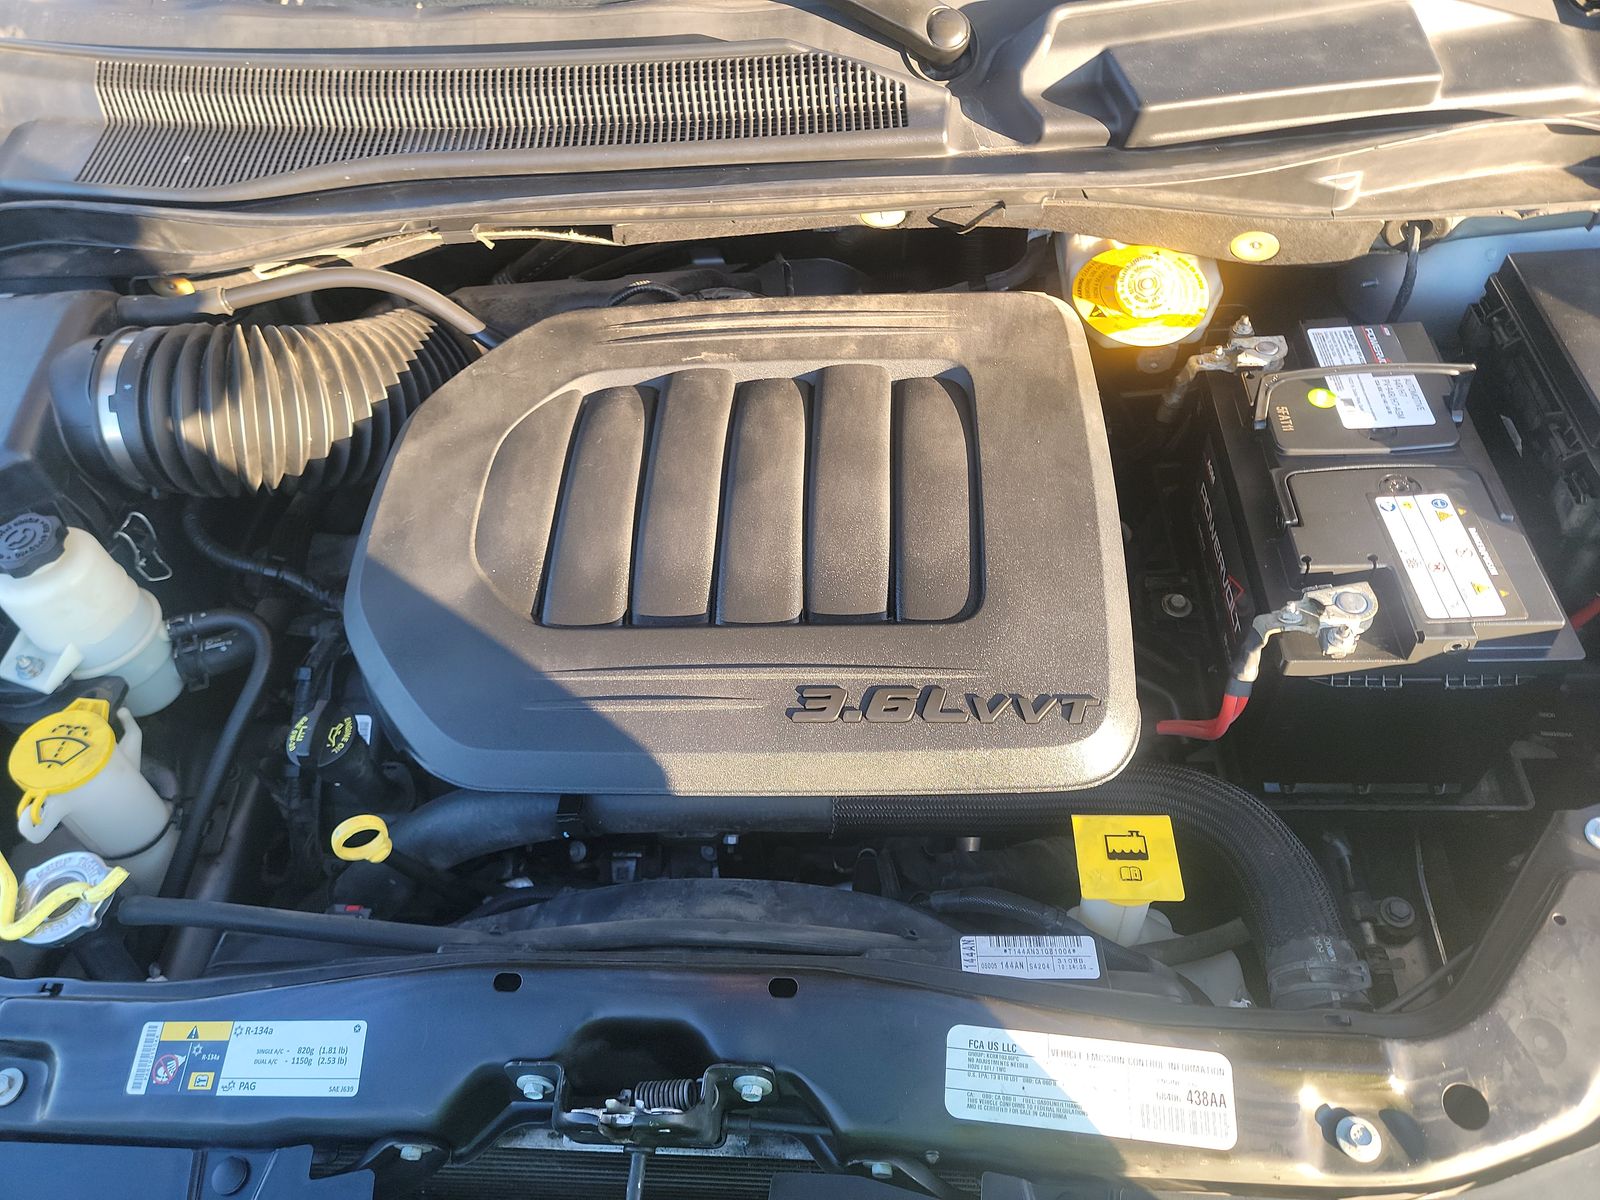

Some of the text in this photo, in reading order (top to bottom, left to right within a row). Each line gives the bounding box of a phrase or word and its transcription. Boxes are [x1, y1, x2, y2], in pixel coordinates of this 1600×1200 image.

[1200, 481, 1242, 633] POWERVOLT
[341, 716, 353, 743] ENGINE
[1000, 961, 1025, 970] 144AN
[245, 1026, 274, 1035] R-134a
[297, 1046, 315, 1056] 820g
[319, 1046, 337, 1056] (1.81
[338, 1046, 348, 1056] lb)
[968, 1039, 1017, 1053] FCA US LLC
[201, 1053, 220, 1061] R-134a
[268, 1058, 278, 1066] A/C
[291, 1057, 313, 1067] 1150g
[317, 1056, 336, 1067] (2.53
[337, 1056, 347, 1066] lb)
[1050, 1049, 1083, 1060] VEHICLE
[1086, 1053, 1126, 1065] EMISSION
[975, 1058, 1010, 1068] ADJUSTMENTS
[238, 1082, 257, 1091] PAG
[329, 1085, 340, 1093] SAE
[1186, 1089, 1227, 1109] 438AA
